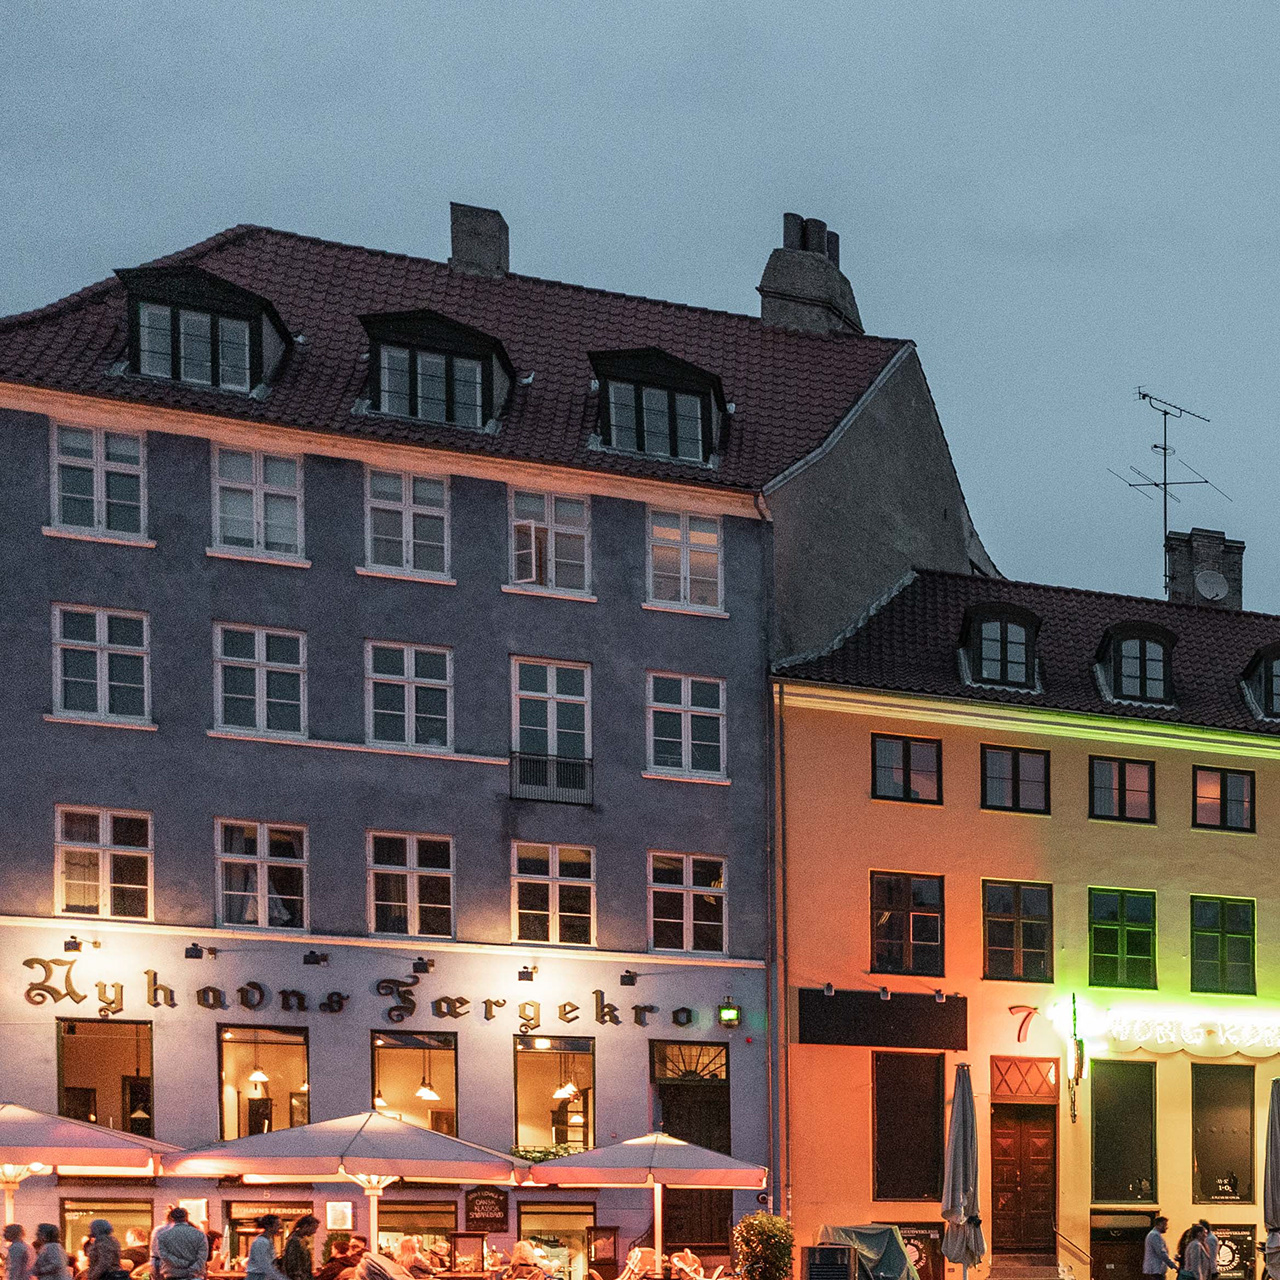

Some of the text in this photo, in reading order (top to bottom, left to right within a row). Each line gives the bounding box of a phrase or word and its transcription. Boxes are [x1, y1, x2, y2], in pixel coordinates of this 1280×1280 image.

[22, 957, 694, 1035] Nyhavns Færgekro
[1008, 1005, 1039, 1043] 7
[263, 1190, 271, 1199] 5
